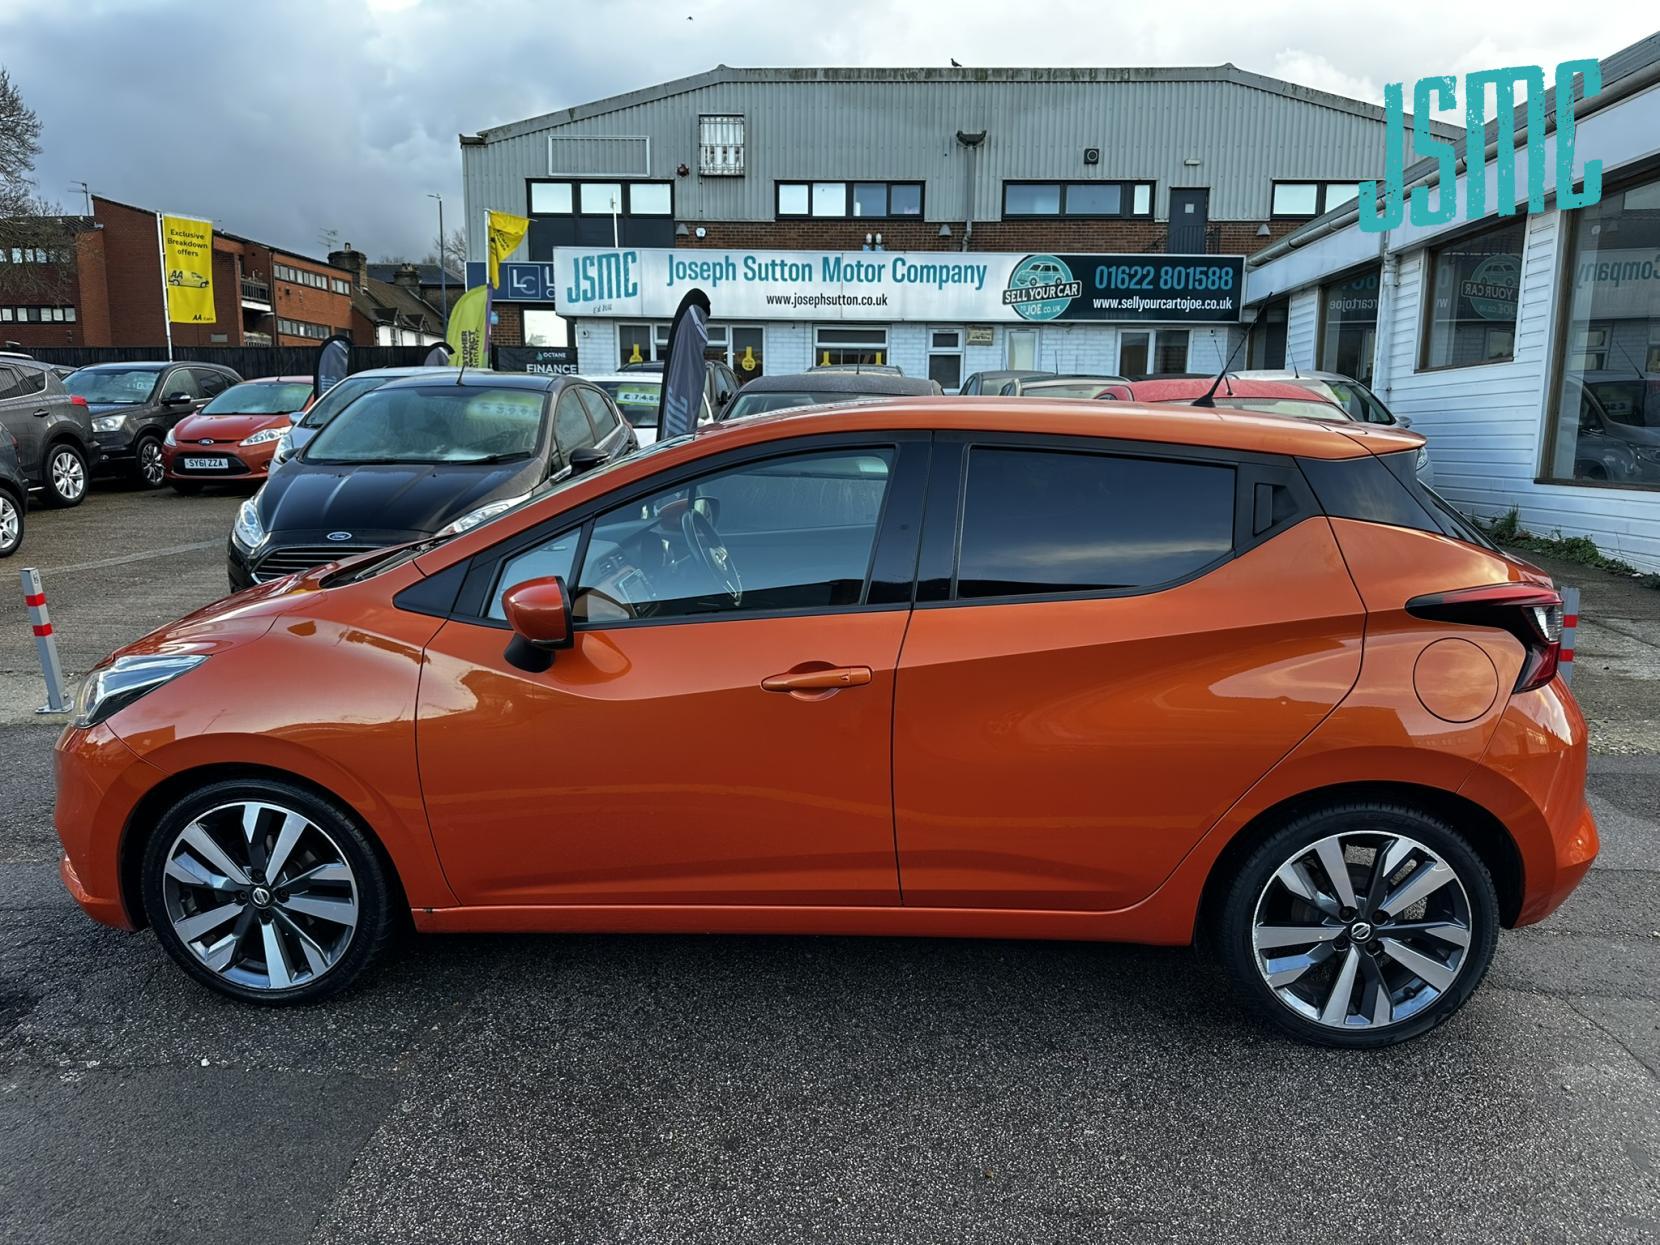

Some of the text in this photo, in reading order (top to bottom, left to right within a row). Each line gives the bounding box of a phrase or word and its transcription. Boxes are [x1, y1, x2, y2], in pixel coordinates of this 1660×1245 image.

[170, 229, 205, 240] Exclusive
[167, 238, 208, 249] Breakdown
[177, 249, 199, 257] offers
[170, 270, 184, 280] AA
[567, 251, 638, 304] JSMC
[667, 254, 988, 290] Joseph Sutton Motor Company
[1095, 265, 1233, 290] 01622 801588
[766, 292, 888, 309] www.josephsutton.co.uk
[1005, 283, 1079, 303] SELL YOUR CAR
[1093, 296, 1232, 312] www.sellyourcartojoe.co.uk
[526, 364, 578, 374] FINANCE
